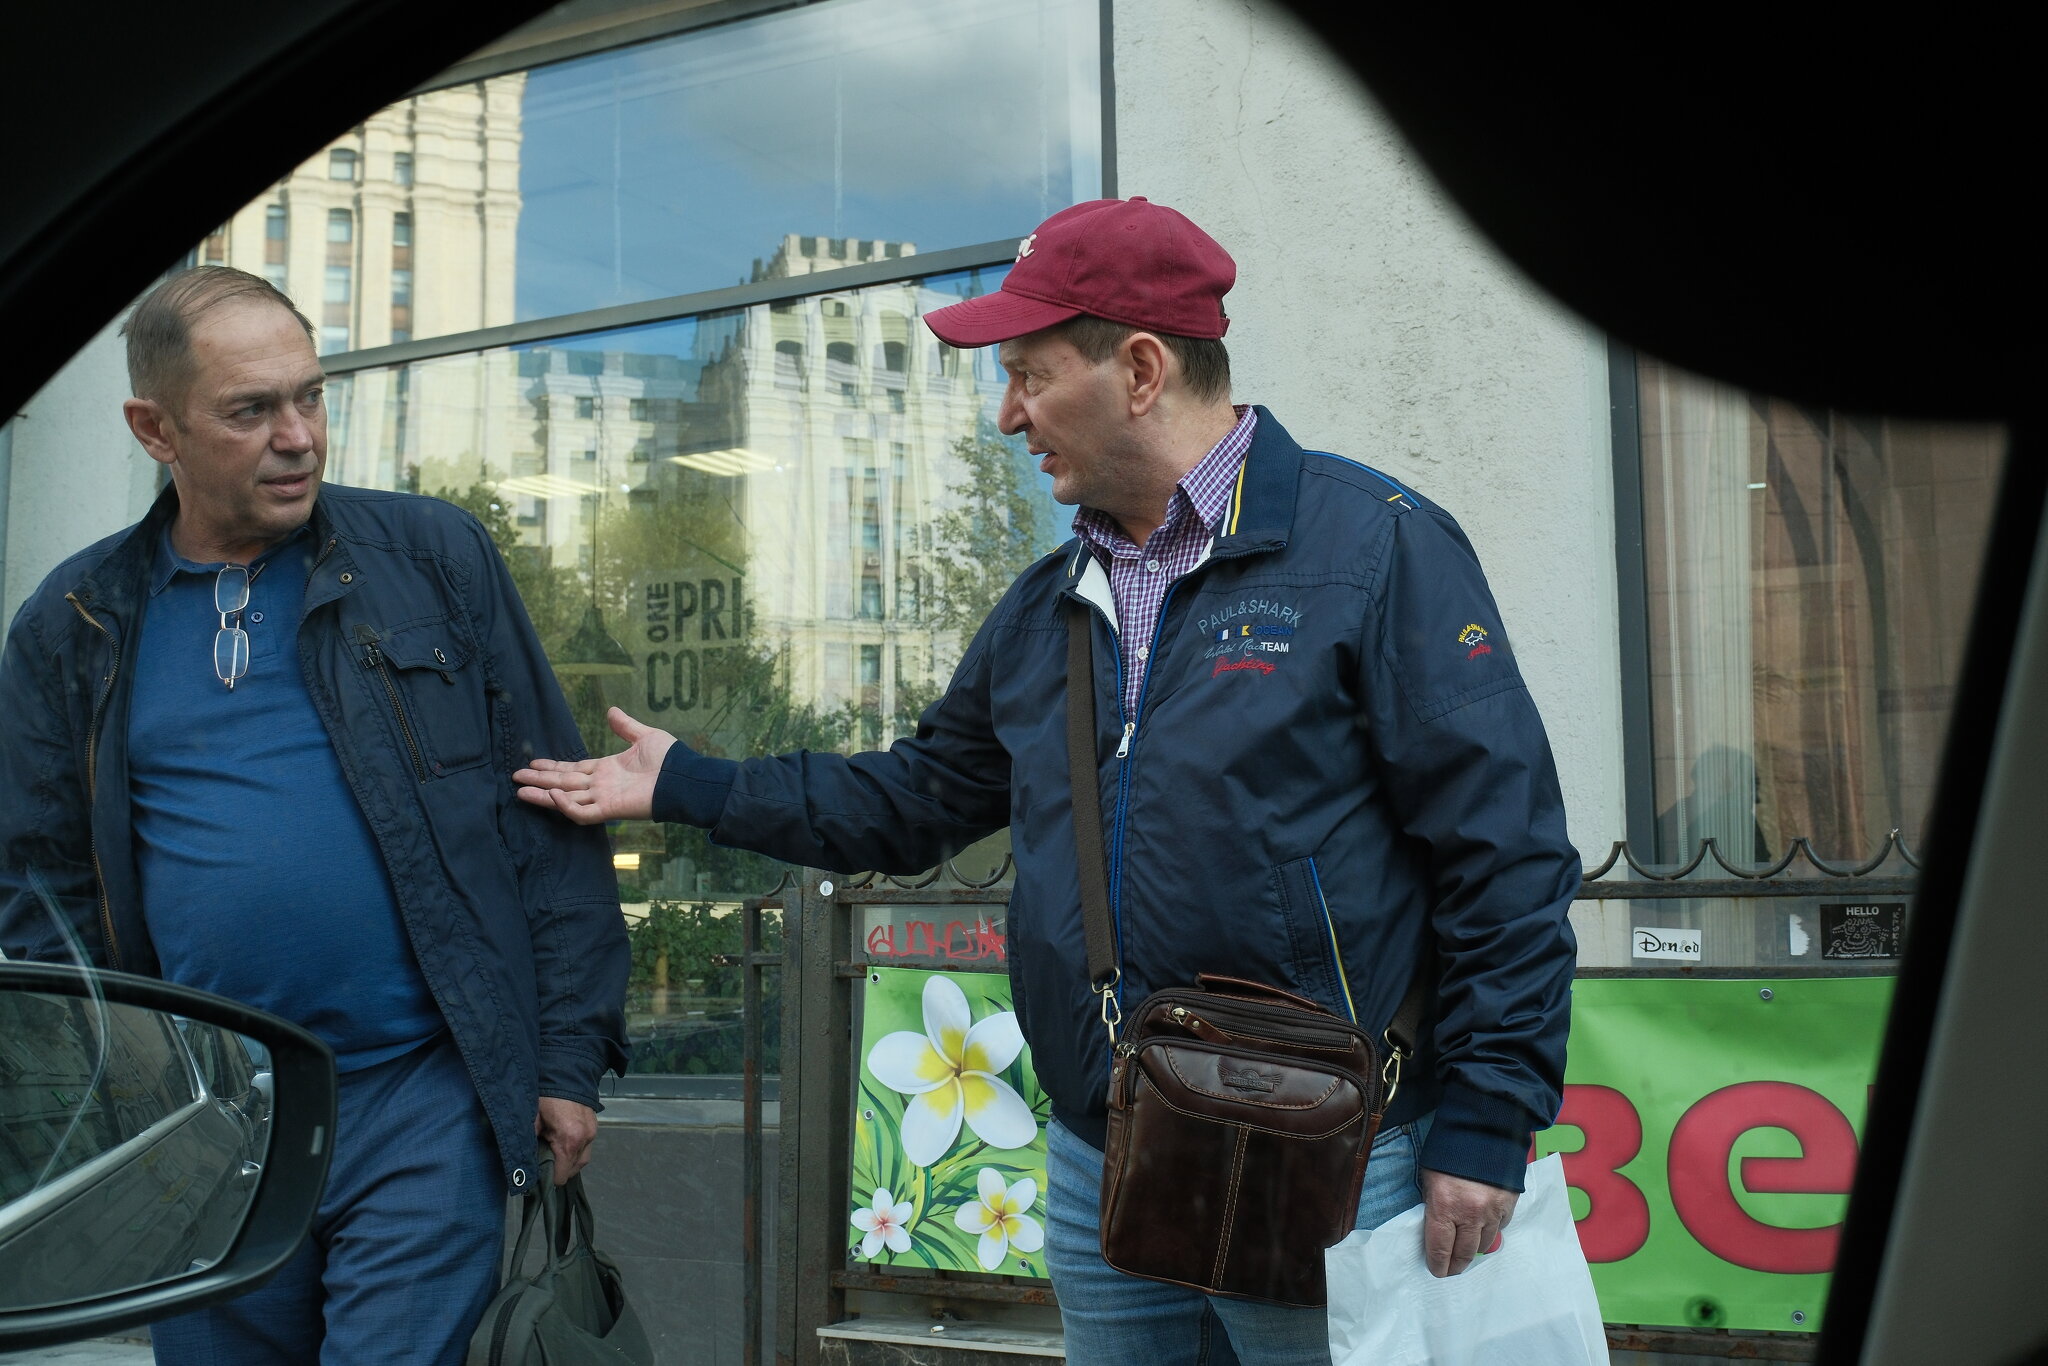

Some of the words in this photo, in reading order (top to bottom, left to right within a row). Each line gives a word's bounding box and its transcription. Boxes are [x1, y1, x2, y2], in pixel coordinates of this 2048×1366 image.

[647, 583, 669, 643] ONE
[1197, 599, 1304, 635] PAUL&SHARK
[1255, 625, 1294, 637] OCEAN
[1261, 641, 1290, 654] TEAM
[1846, 906, 1880, 916] HELLO
